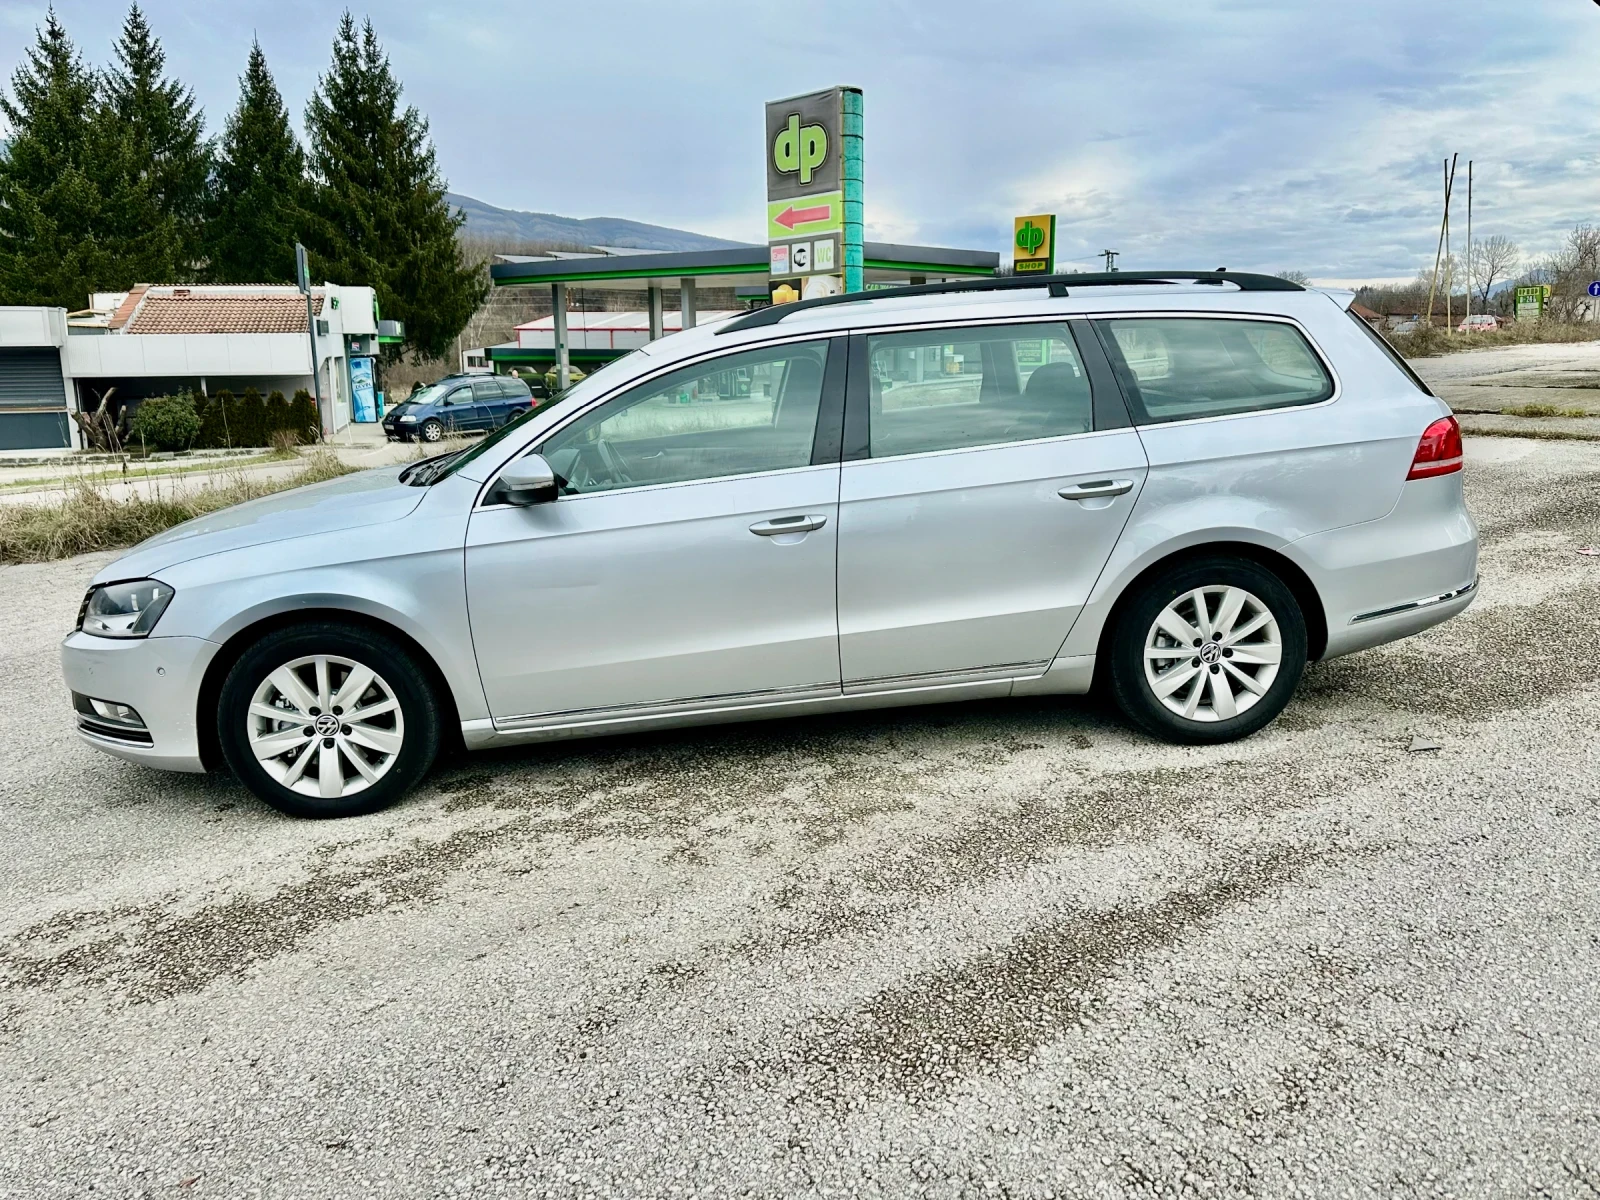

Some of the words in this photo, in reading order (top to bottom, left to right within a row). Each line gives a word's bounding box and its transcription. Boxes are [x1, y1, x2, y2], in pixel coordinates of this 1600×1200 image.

[773, 112, 829, 186] dp
[1016, 221, 1045, 256] dp
[816, 246, 832, 264] WC
[1018, 262, 1044, 270] SHOP
